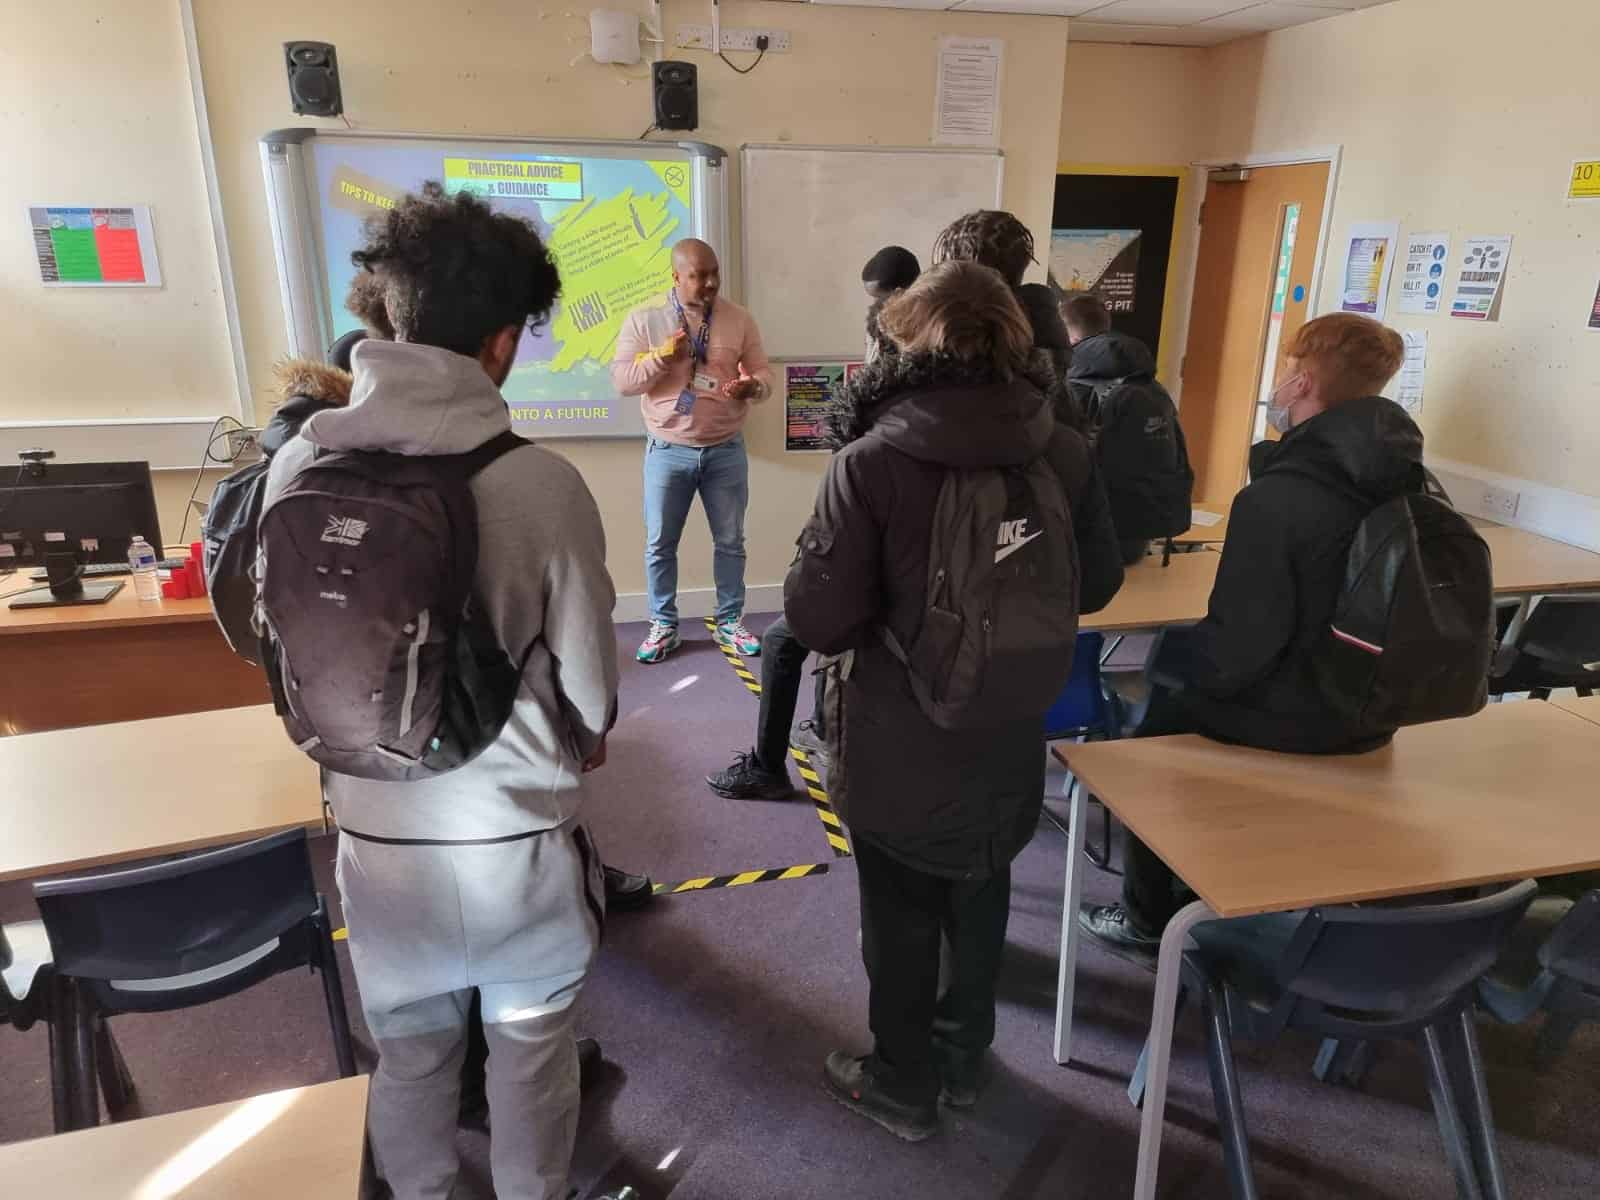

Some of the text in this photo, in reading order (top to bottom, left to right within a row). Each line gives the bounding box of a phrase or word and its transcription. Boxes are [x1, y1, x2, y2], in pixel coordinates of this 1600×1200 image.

[468, 161, 563, 179] PRACTICAL ADVICE
[1575, 164, 1593, 181] 10
[340, 180, 361, 200] TIPS
[362, 190, 376, 205] TO
[497, 181, 549, 196] GUIDANCE
[1114, 300, 1133, 311] PIT
[511, 407, 609, 420] NTO A FUTURE
[997, 518, 1028, 545] IKE
